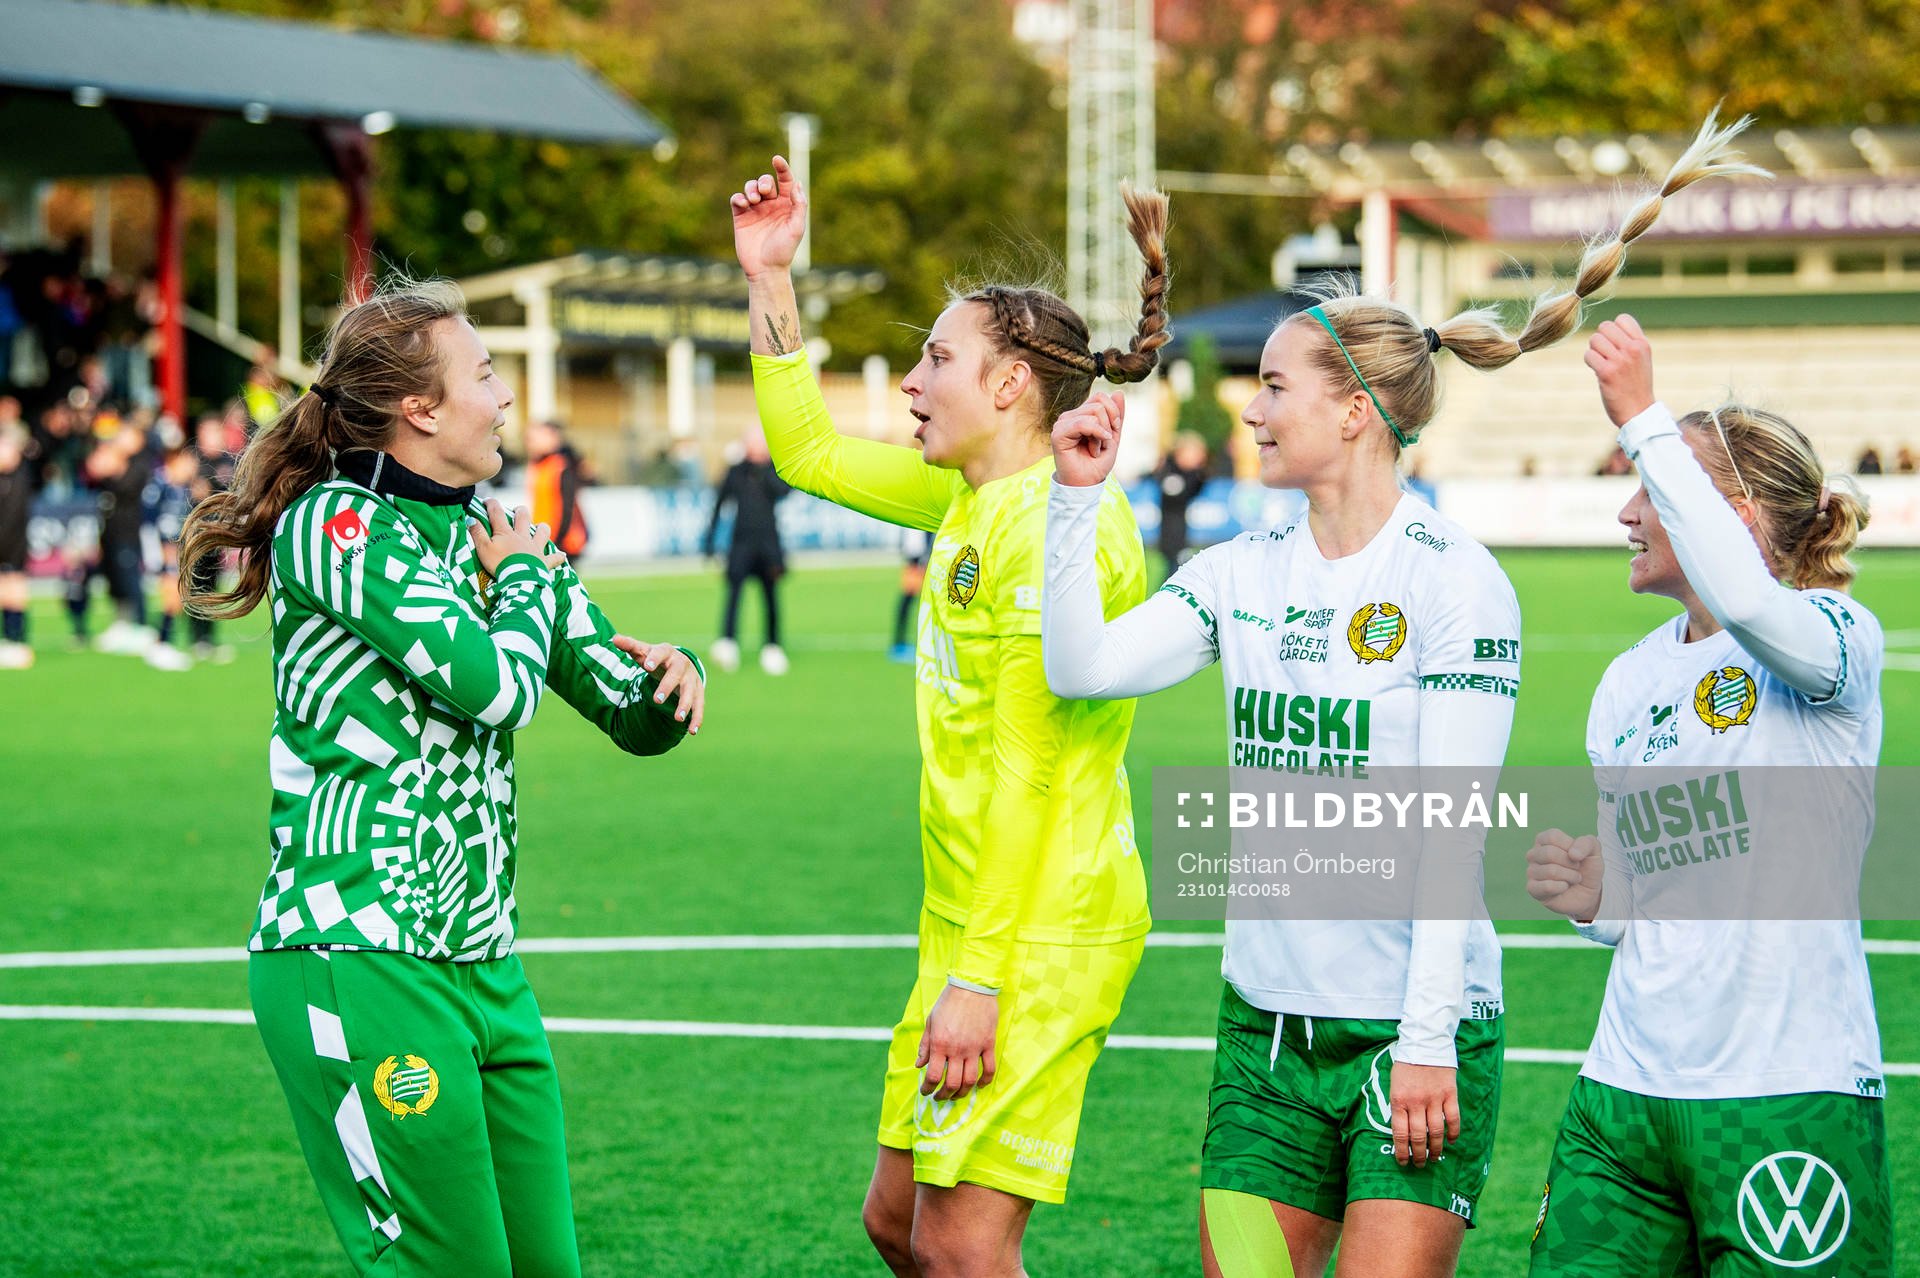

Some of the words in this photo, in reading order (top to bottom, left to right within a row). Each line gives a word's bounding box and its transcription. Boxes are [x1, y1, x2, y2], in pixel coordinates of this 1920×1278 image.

[335, 542, 370, 573] SVENSKA
[369, 532, 392, 545] SPEL
[1405, 522, 1454, 552] Convini
[1473, 638, 1519, 660] BST
[1234, 687, 1371, 751] HUSKI
[1234, 742, 1369, 780] CHOCOLATE
[1616, 769, 1749, 850] HUSKI
